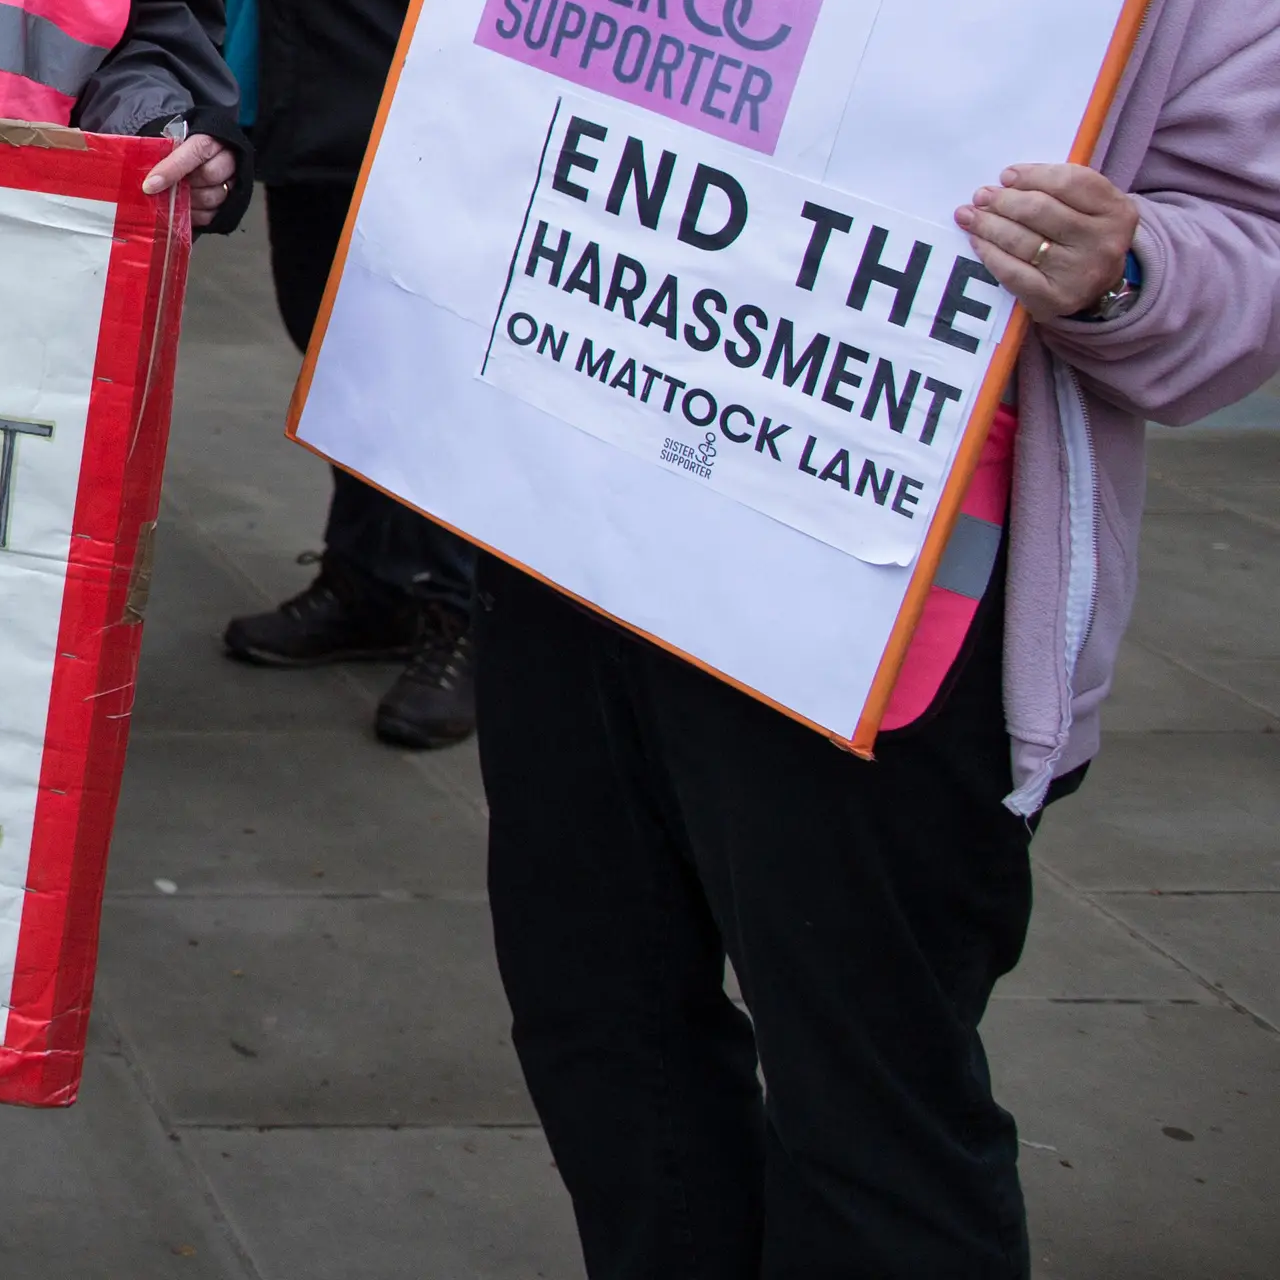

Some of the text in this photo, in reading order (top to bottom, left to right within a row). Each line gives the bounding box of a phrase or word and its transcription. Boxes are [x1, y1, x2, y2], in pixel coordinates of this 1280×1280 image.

[524, 219, 963, 447] HARASSMENT
[551, 115, 999, 355] END THE
[506, 310, 925, 520] ON MATTOCK LANE
[660, 449, 712, 480] SUPPORTER
[663, 437, 695, 460] SISTER
